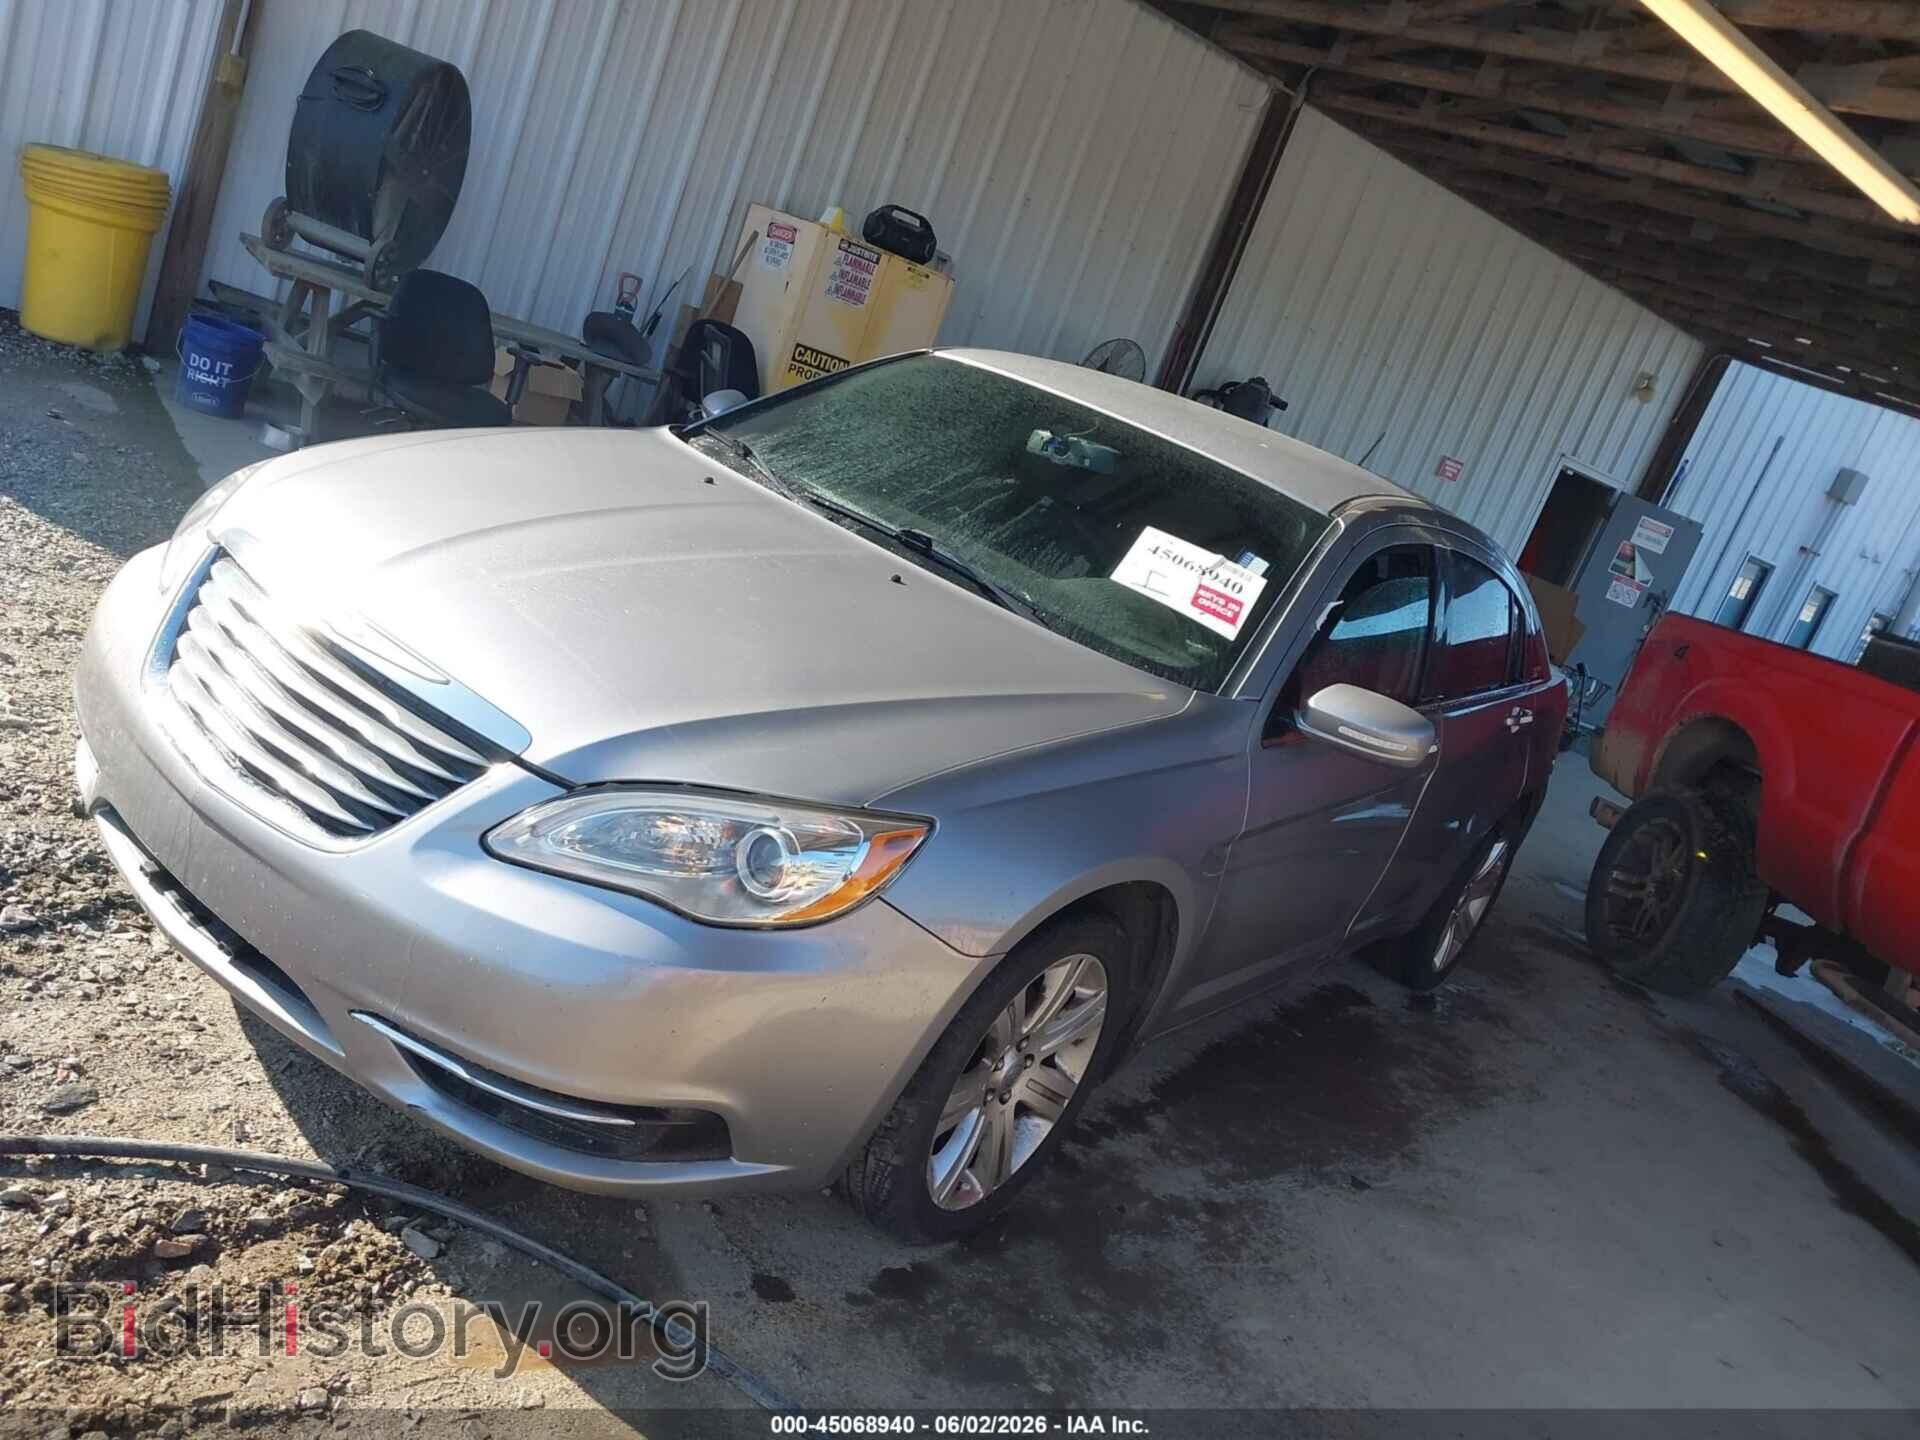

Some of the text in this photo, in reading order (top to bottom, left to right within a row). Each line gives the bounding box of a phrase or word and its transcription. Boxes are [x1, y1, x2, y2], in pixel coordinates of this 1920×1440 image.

[190, 353, 233, 376] DO IT
[187, 367, 231, 388] RIGHT
[1197, 596, 1234, 617] OFFICE
